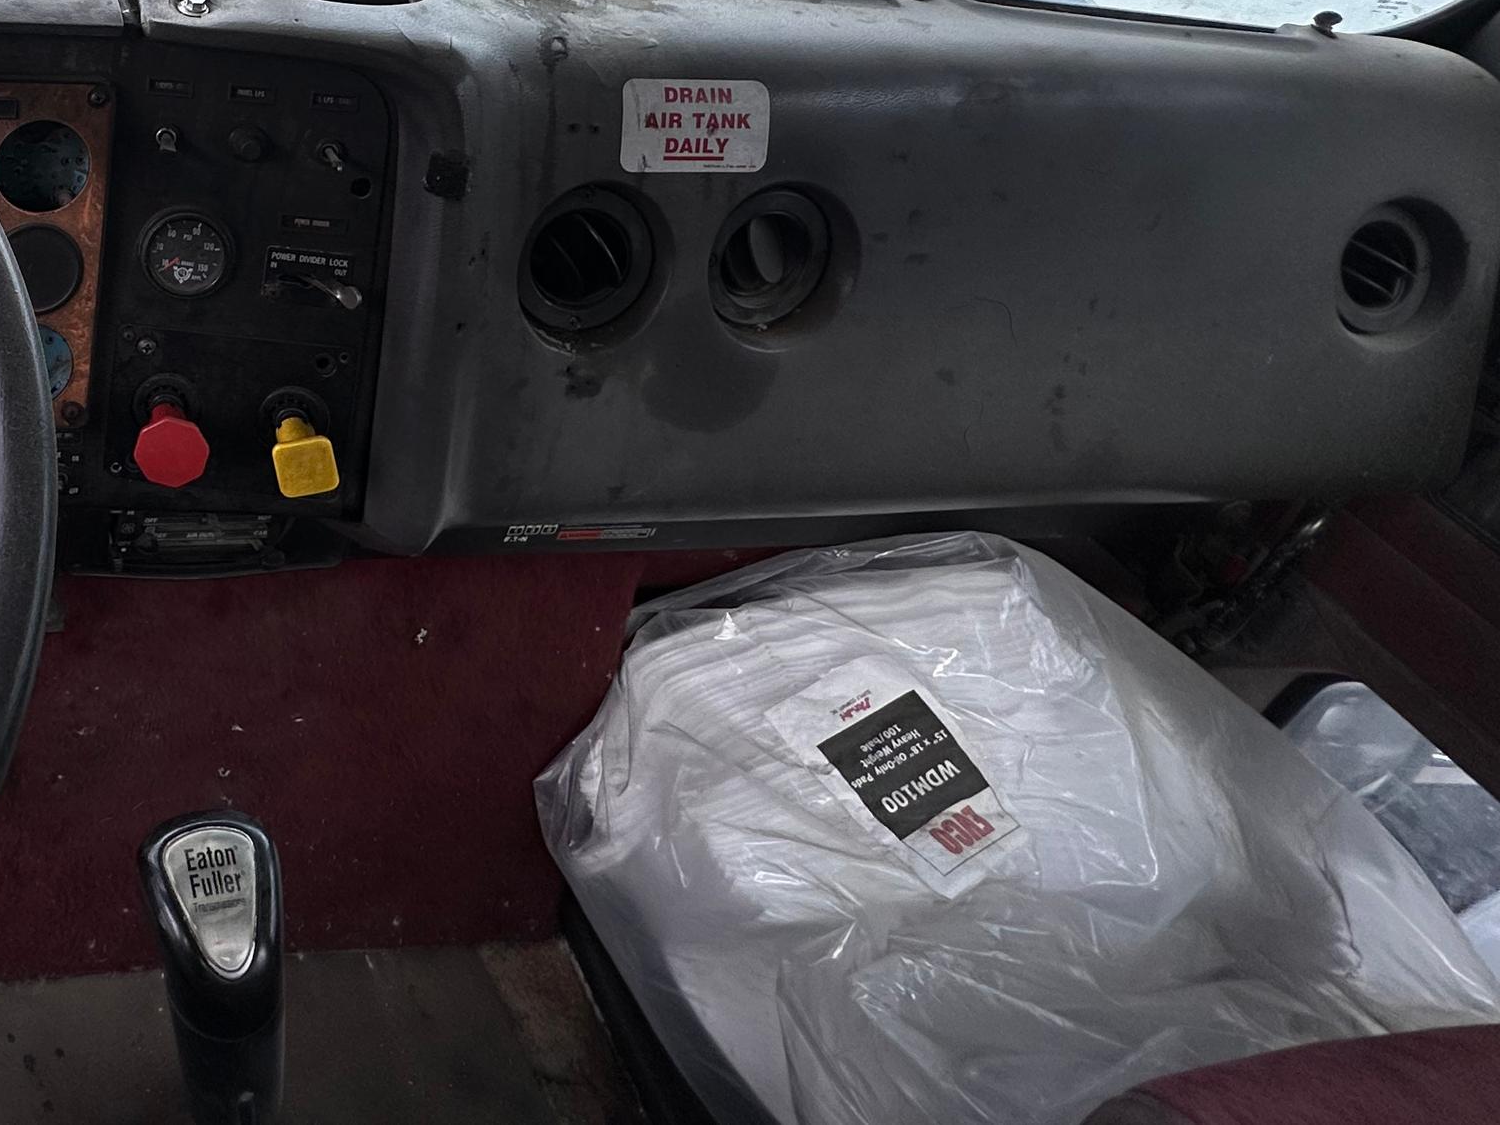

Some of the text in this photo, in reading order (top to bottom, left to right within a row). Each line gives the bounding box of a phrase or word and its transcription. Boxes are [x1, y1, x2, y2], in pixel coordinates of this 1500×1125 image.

[664, 86, 732, 104] DRAIN
[644, 112, 751, 129] AIR TANK
[664, 138, 729, 154] DAILY
[271, 251, 349, 268] POWER DIVIDER LOCK
[860, 724, 902, 753] 100/bale
[860, 729, 921, 768] Heavy Weight
[851, 774, 874, 789] Pads
[881, 759, 961, 813] WDM100
[184, 846, 238, 872] Eaton
[189, 871, 242, 899] Fuller
